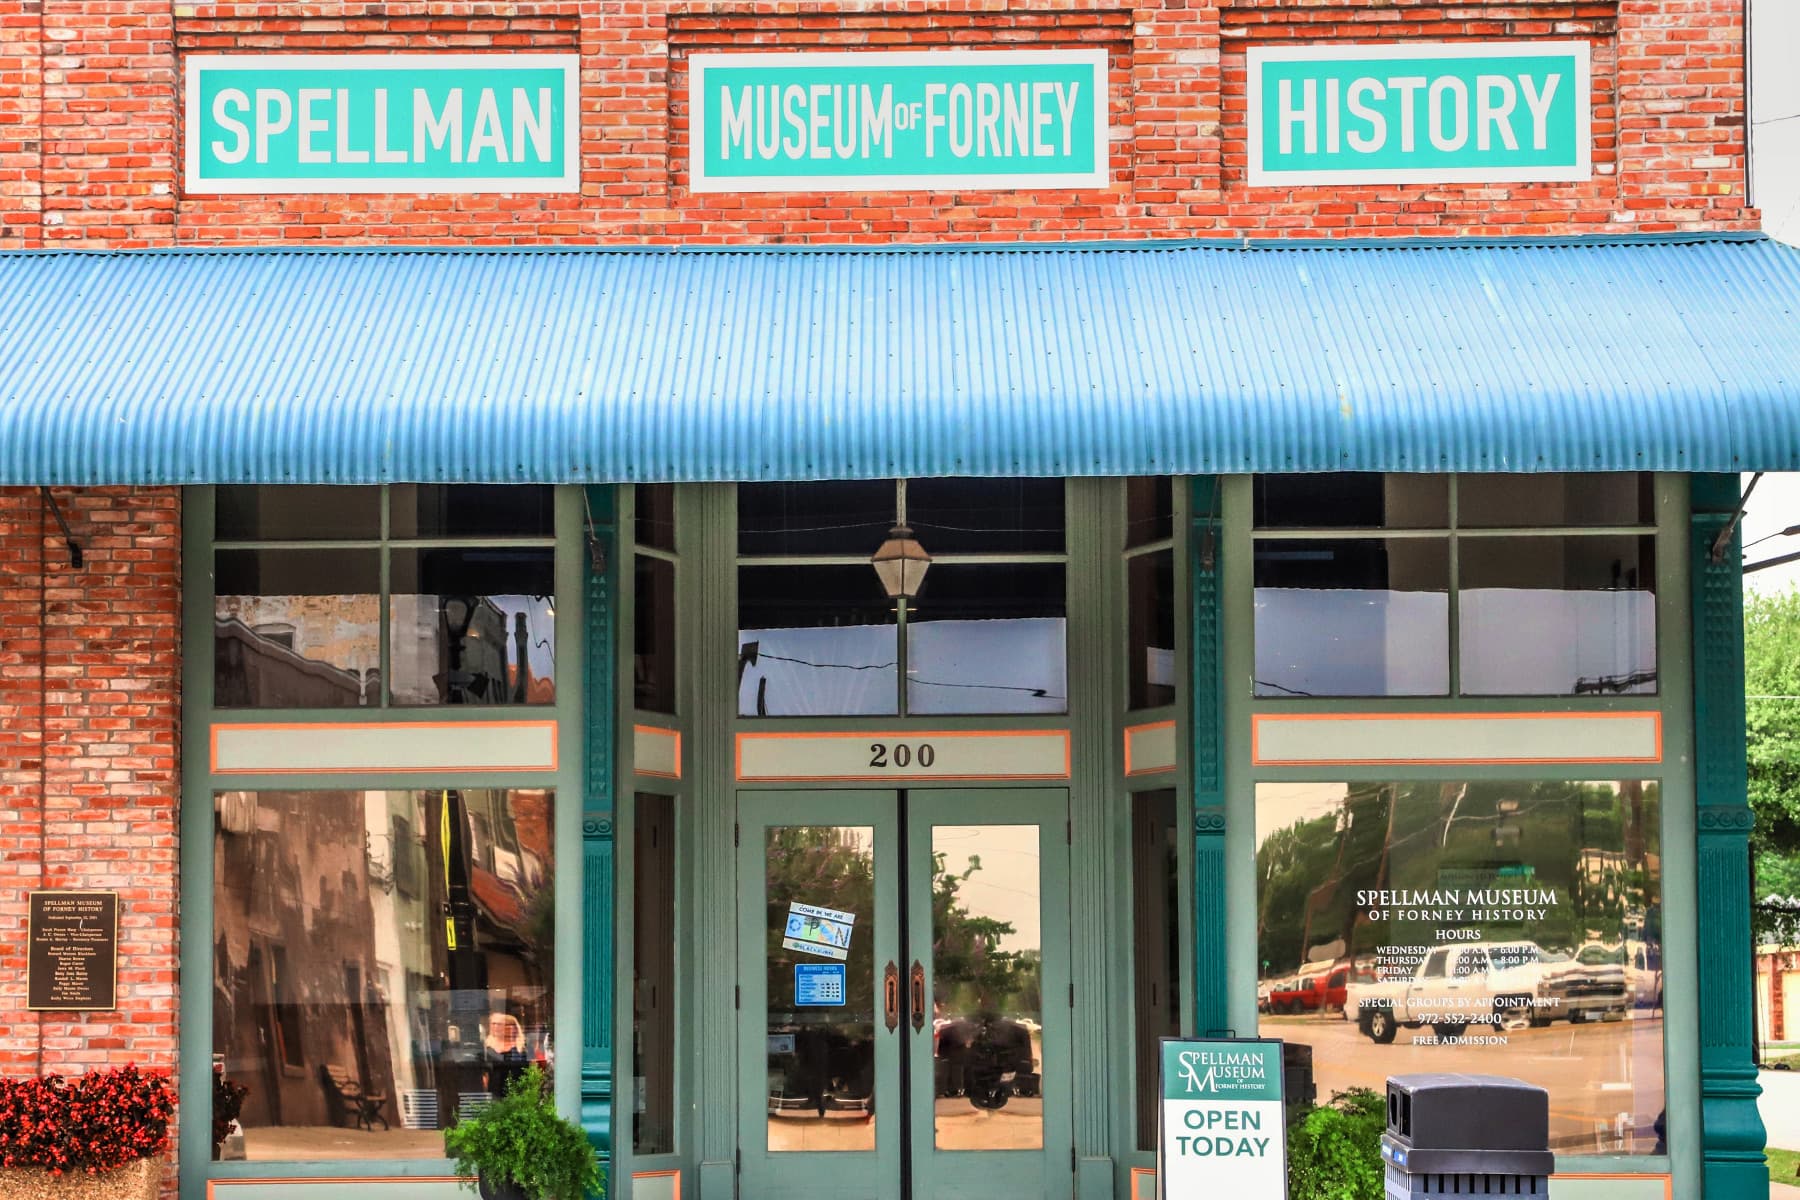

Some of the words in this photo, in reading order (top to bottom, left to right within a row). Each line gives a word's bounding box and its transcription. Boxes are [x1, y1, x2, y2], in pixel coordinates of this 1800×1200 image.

[720, 83, 893, 161] MUSEUM
[894, 102, 923, 131] OF
[925, 81, 1080, 159] FORNEY
[1278, 73, 1562, 155] HISTORY
[211, 87, 552, 165] SPELLMAN
[869, 743, 935, 767] 200
[1356, 889, 1460, 906] SPELLMAN
[1466, 889, 1558, 905] MUSEUM
[1368, 909, 1390, 921] OF
[1398, 909, 1464, 921] FORNEY
[1472, 909, 1547, 921] HISTORY
[1436, 929, 1481, 940] HOURS
[1500, 946, 1520, 954] 6:00
[1376, 956, 1430, 965] THURSDA
[1500, 956, 1520, 964] 8:00
[1376, 966, 1413, 975] FRIDAY
[1377, 976, 1426, 985] SATURD
[1359, 997, 1404, 1008] SPECIAL
[1407, 997, 1454, 1008] GROUPS
[1457, 997, 1473, 1008] BY
[1475, 997, 1561, 1008] APPOINTMENT
[1417, 1013, 1502, 1025] 972-552-2400
[1412, 1035, 1439, 1046] FREE
[1440, 1035, 1508, 1046] ADMISSION
[1178, 1051, 1264, 1078] SPELLMAN
[1185, 1066, 1265, 1092] MUSEUM
[1183, 1109, 1261, 1130] OPEN
[1175, 1136, 1271, 1157] TODAY
